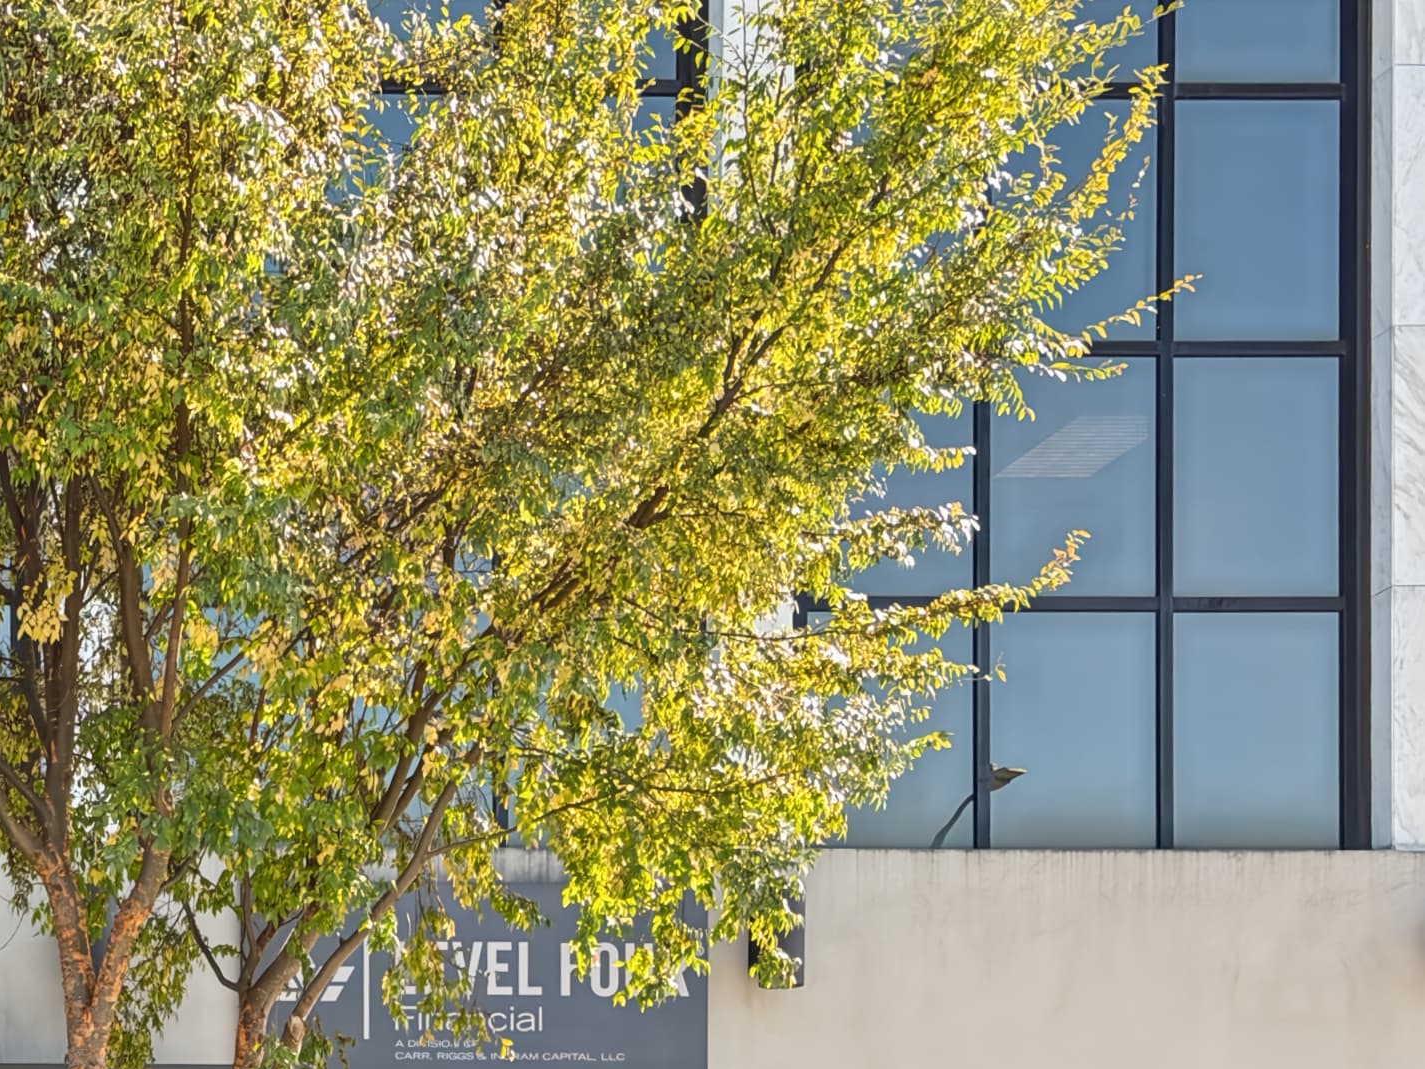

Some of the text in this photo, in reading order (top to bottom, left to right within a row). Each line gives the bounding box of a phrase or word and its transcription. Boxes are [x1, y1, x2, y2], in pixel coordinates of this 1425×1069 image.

[394, 941, 543, 996] LVEL
[395, 1039, 404, 1048] A
[437, 1051, 475, 1061] RIGGS
[600, 1052, 626, 1061] LLC
